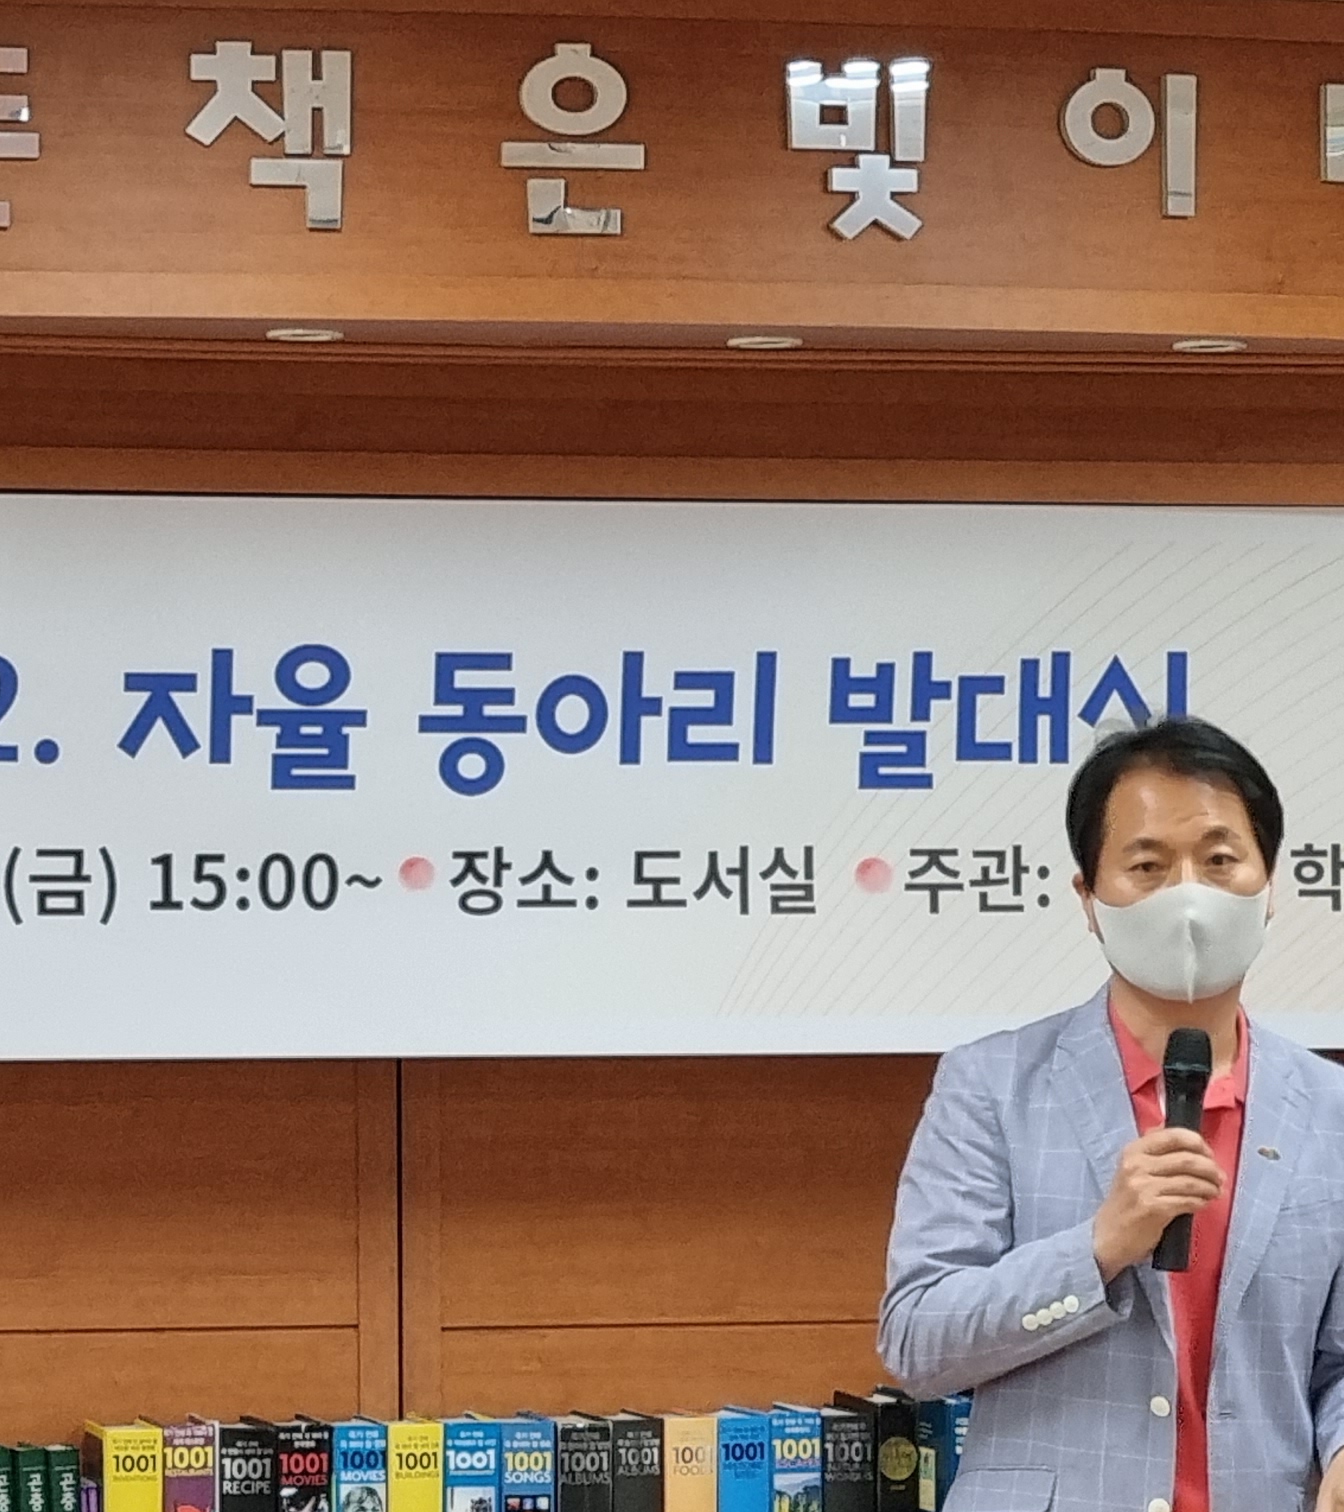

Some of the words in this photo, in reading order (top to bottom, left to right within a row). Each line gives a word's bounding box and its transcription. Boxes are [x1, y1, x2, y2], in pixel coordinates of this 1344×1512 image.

[117, 643, 368, 790] 자율
[418, 650, 779, 796] 동아리
[149, 851, 384, 912] 15:00~
[450, 845, 600, 917] 장소:
[626, 845, 818, 917] 도서실
[903, 845, 1051, 916] 주관:
[163, 1446, 214, 1469] 1001
[340, 1450, 386, 1470] 1001
[445, 1448, 496, 1471] 1001
[617, 1446, 659, 1466] 1001
[721, 1441, 765, 1462] 1001
[771, 1438, 821, 1460] 1001
[824, 1441, 873, 1462] 1001
[112, 1454, 157, 1473] 1001
[221, 1457, 272, 1479] 1001
[278, 1451, 329, 1474] 1001
[396, 1451, 439, 1470] 1001
[504, 1451, 552, 1472] 1001
[560, 1450, 609, 1472] 1001
[279, 1474, 329, 1486] MOVIES
[340, 1470, 386, 1481] MOVIES
[504, 1470, 552, 1484] SONGS
[26, 1472, 45, 1512] 곤충
[59, 1472, 77, 1512] 곤충
[222, 1480, 271, 1496] RECIPE
